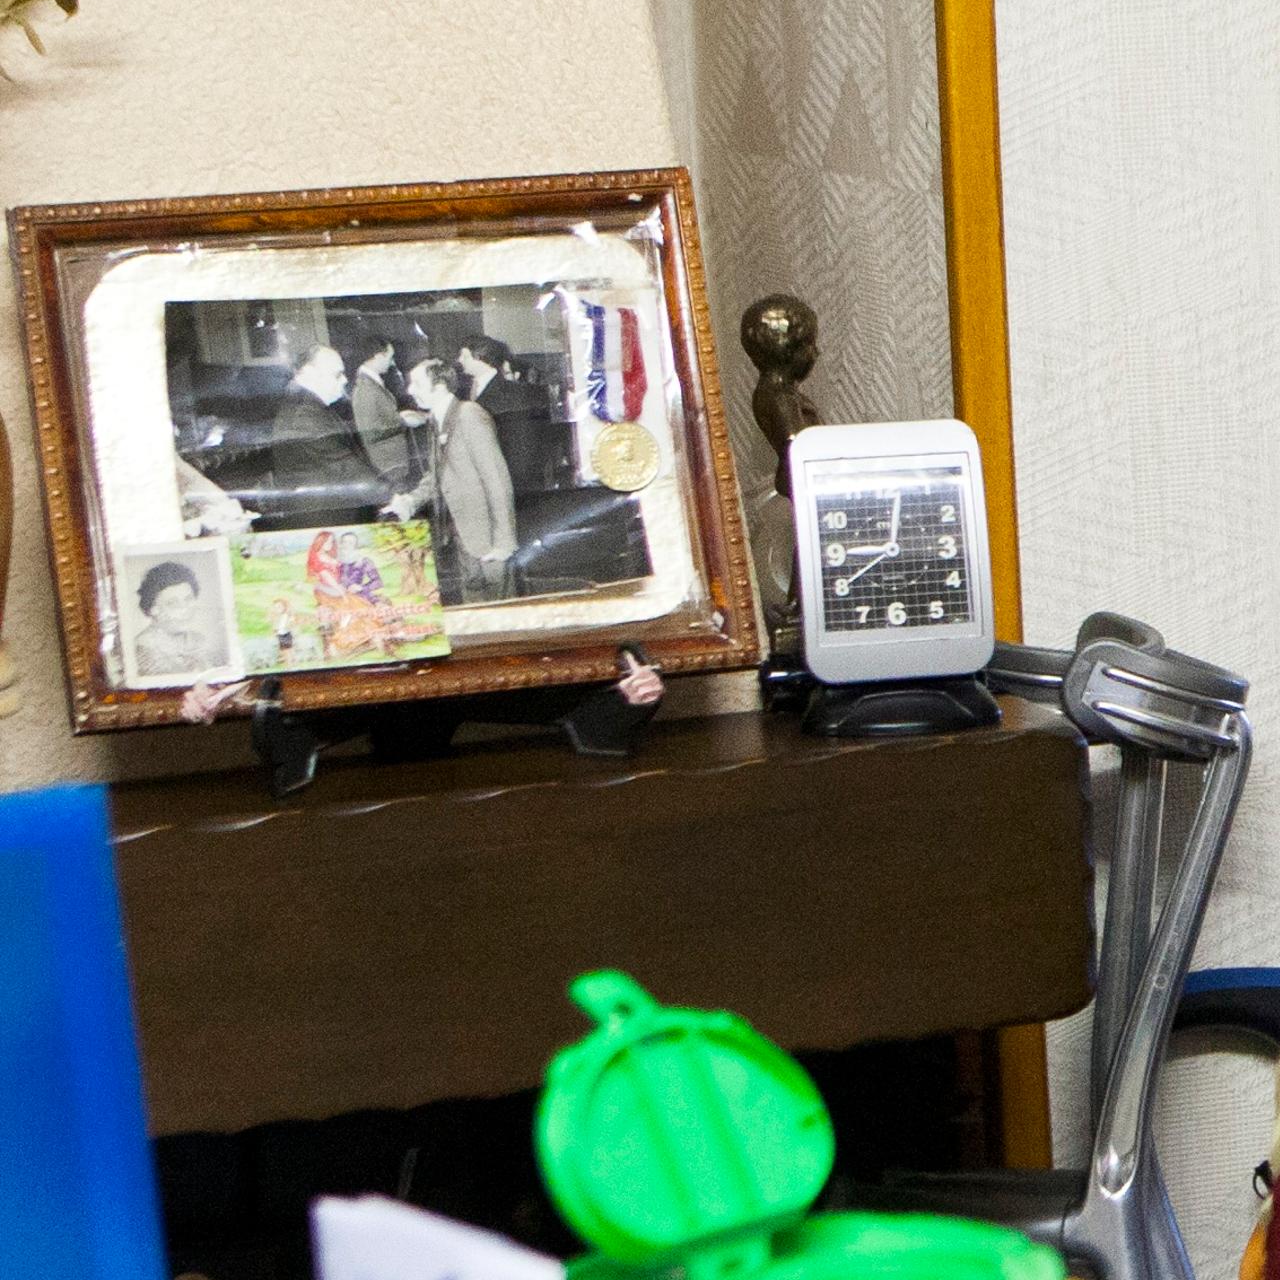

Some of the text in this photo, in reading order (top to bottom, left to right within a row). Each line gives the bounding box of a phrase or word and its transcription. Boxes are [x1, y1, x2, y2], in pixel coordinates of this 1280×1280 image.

[822, 511, 848, 529] 10
[940, 505, 956, 523] 2
[826, 542, 846, 567] 9
[938, 535, 957, 560] 3
[835, 578, 850, 597] 8
[945, 570, 962, 589] 4
[855, 605, 871, 624] 7
[887, 602, 907, 625] 6
[929, 600, 945, 619] 5
